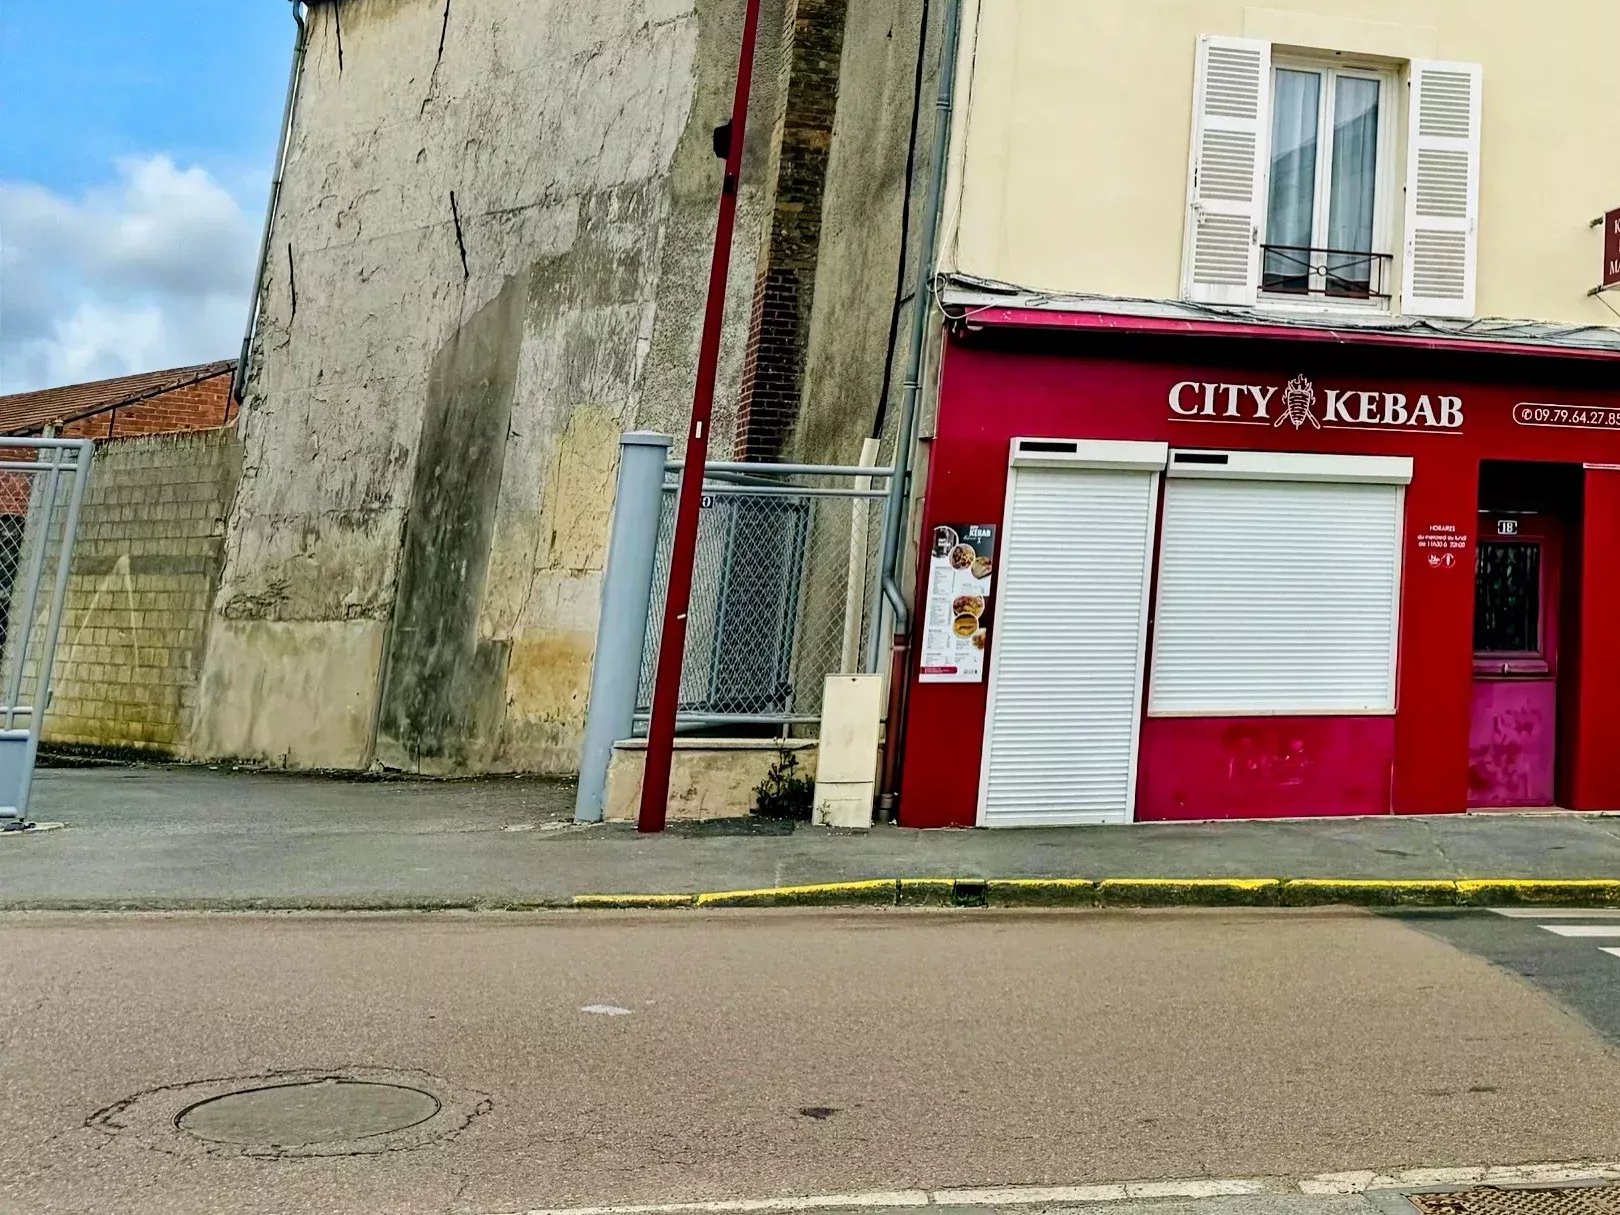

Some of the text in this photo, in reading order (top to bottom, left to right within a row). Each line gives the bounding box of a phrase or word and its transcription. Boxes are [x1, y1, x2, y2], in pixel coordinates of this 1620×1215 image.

[1168, 381, 1464, 428] CITY KEBAB
[1502, 522, 1514, 533] 18
